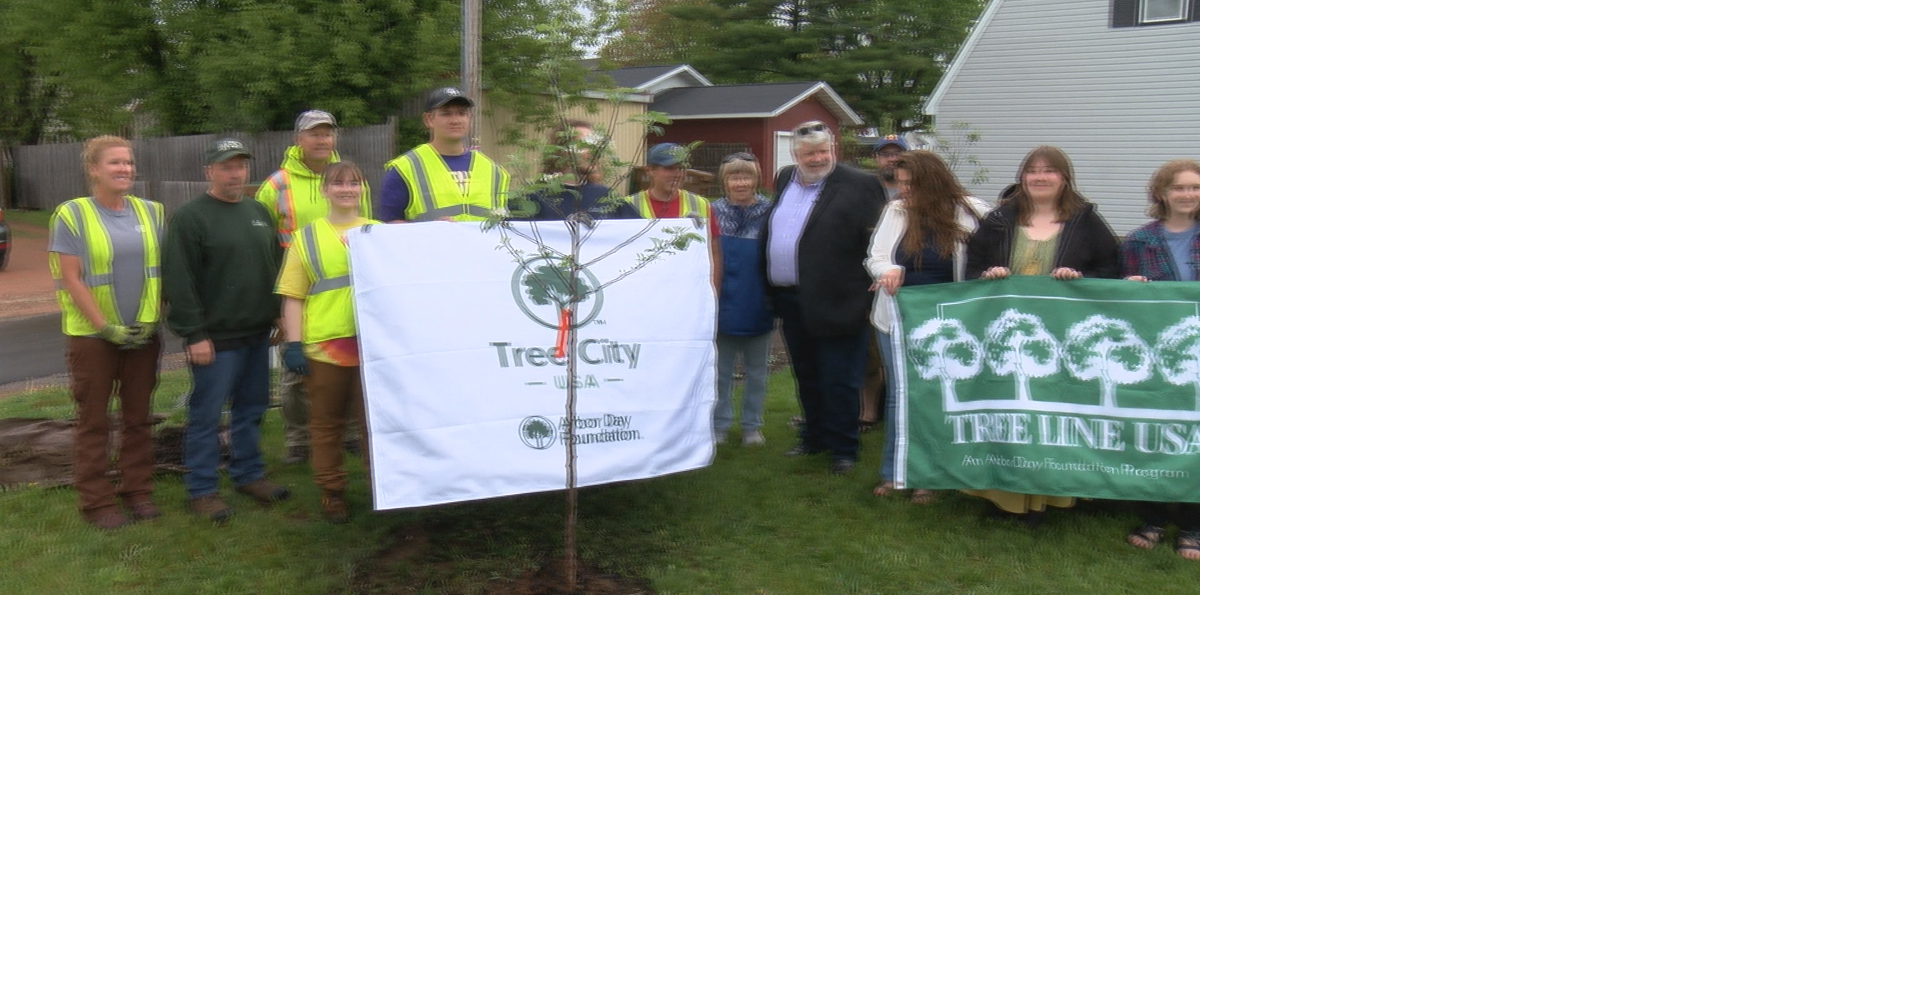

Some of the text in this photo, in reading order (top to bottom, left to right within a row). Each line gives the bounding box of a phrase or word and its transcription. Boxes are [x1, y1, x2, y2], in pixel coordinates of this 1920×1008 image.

[489, 338, 641, 369] Tree City
[553, 374, 600, 390] USA
[603, 413, 632, 429] Day
[559, 428, 641, 445] Foundation
[945, 413, 1033, 444] TREE
[1036, 414, 1126, 452] LINE
[961, 455, 984, 466] An
[1013, 456, 1043, 471] Day
[1044, 457, 1119, 474] Foundation
[1120, 463, 1190, 480] Program
